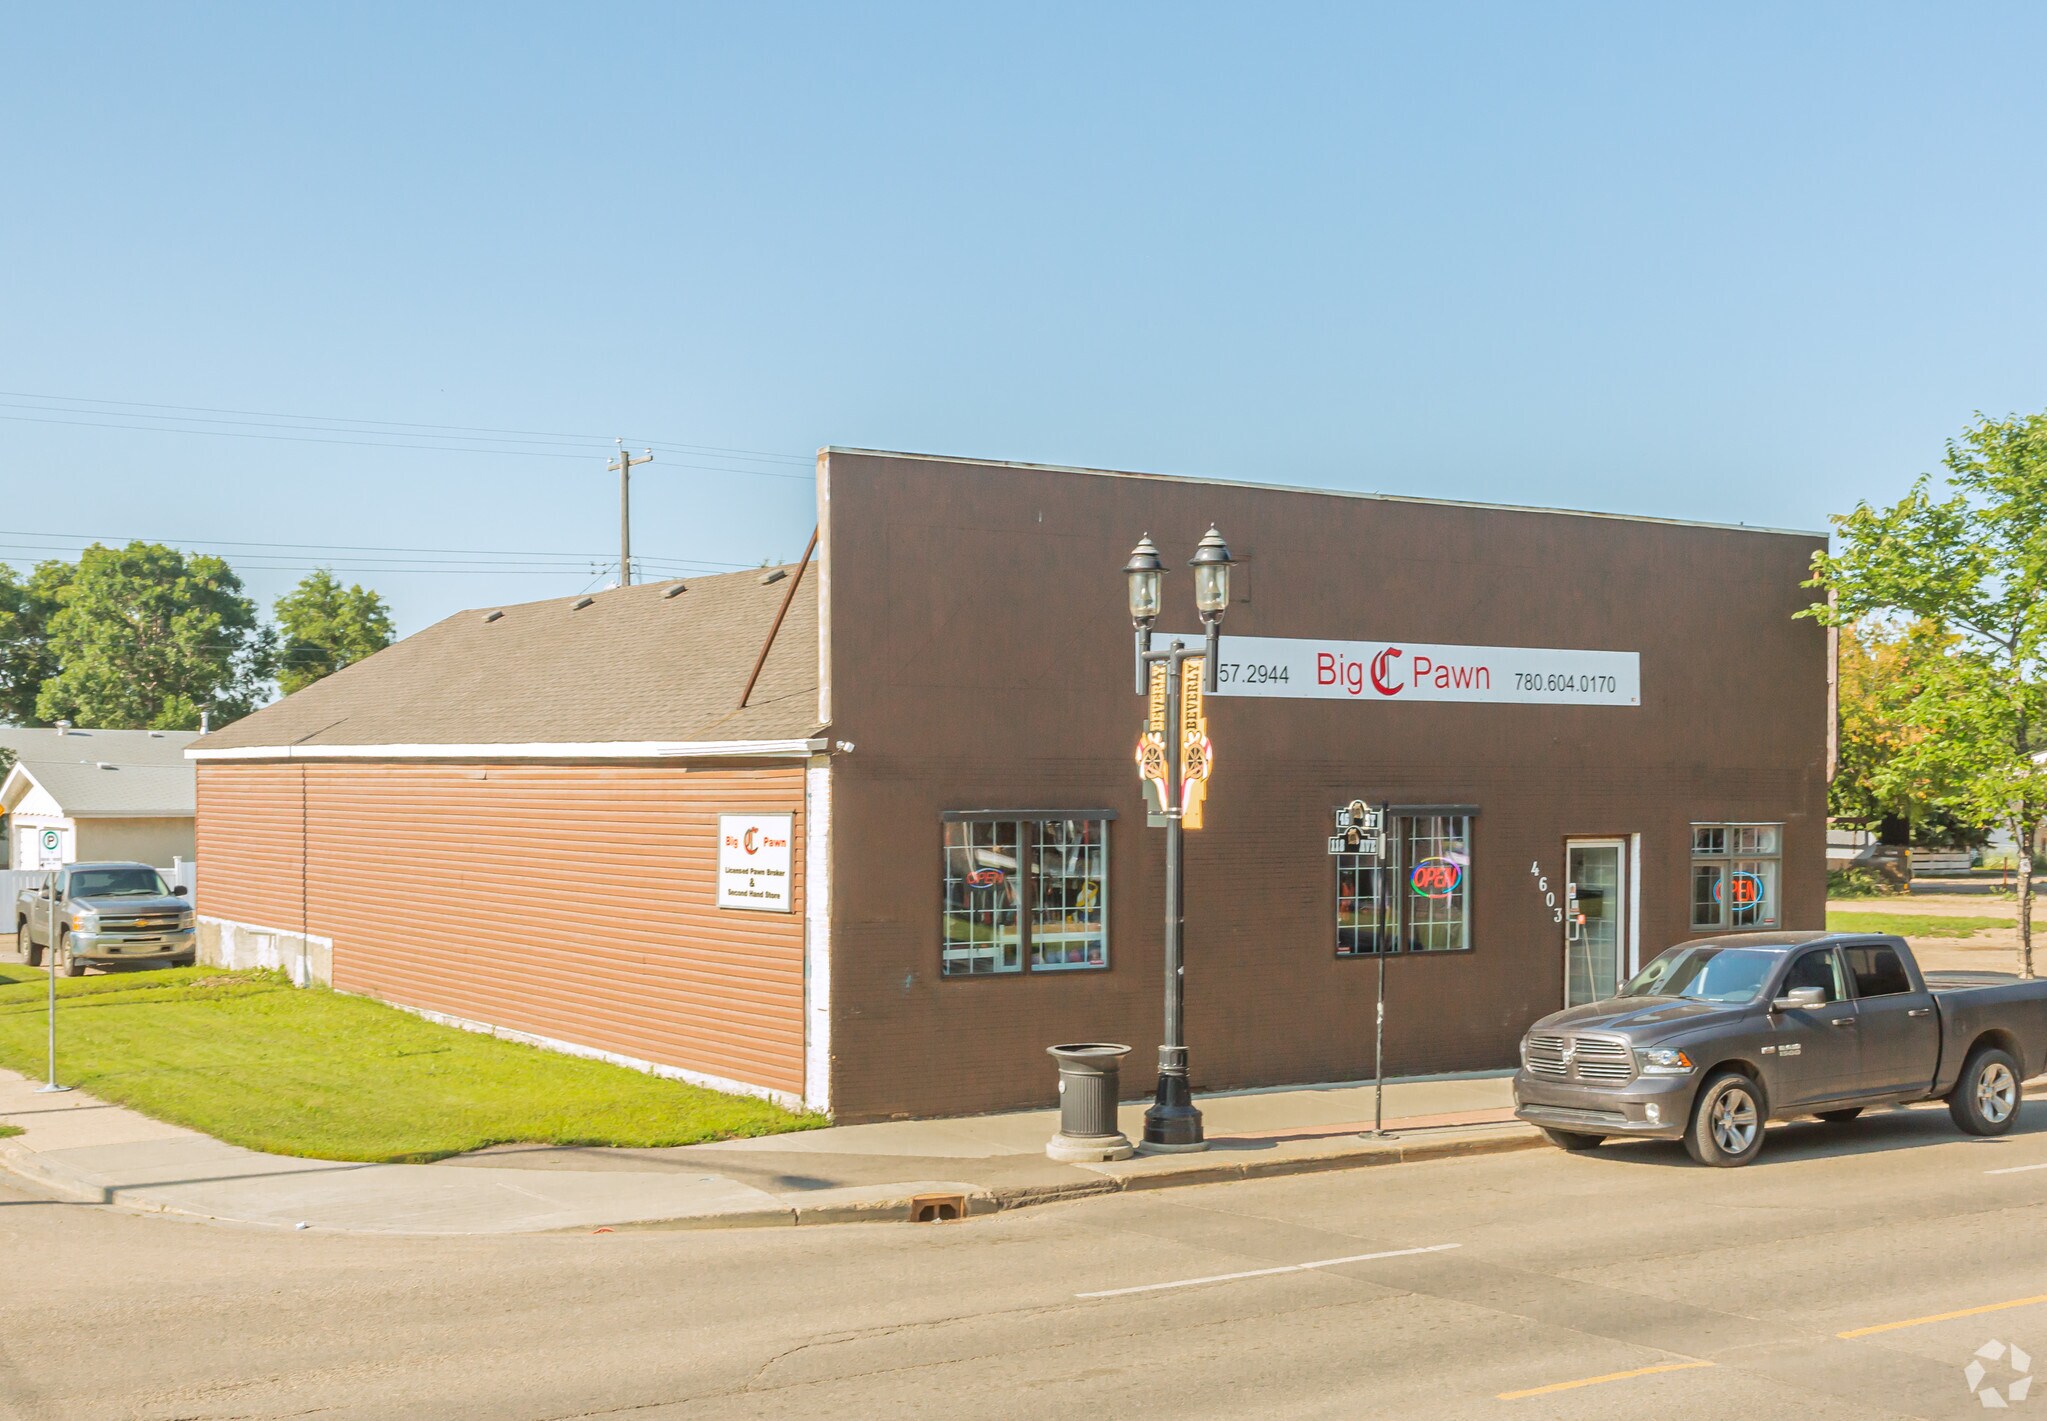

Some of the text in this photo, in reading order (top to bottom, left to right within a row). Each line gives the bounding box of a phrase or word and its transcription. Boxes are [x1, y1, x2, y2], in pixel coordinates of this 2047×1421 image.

[1317, 652, 1363, 695] Big
[1370, 647, 1405, 696] C
[1413, 656, 1491, 690] Pawn
[1515, 673, 1616, 693] 780.604.0170
[1150, 665, 1166, 732] BEVERLY
[1186, 664, 1201, 730] BEVERLY
[1364, 813, 1377, 827] ST
[725, 826, 787, 856] Big C Pawn
[1359, 839, 1376, 853] AVE
[725, 866, 786, 877] Licensed Pawn Broker
[965, 871, 1004, 885] OPEN
[1413, 867, 1457, 888] OPEN
[749, 878, 755, 888] &
[728, 888, 781, 900] Second Hand Store
[1531, 861, 1563, 923] 4603
